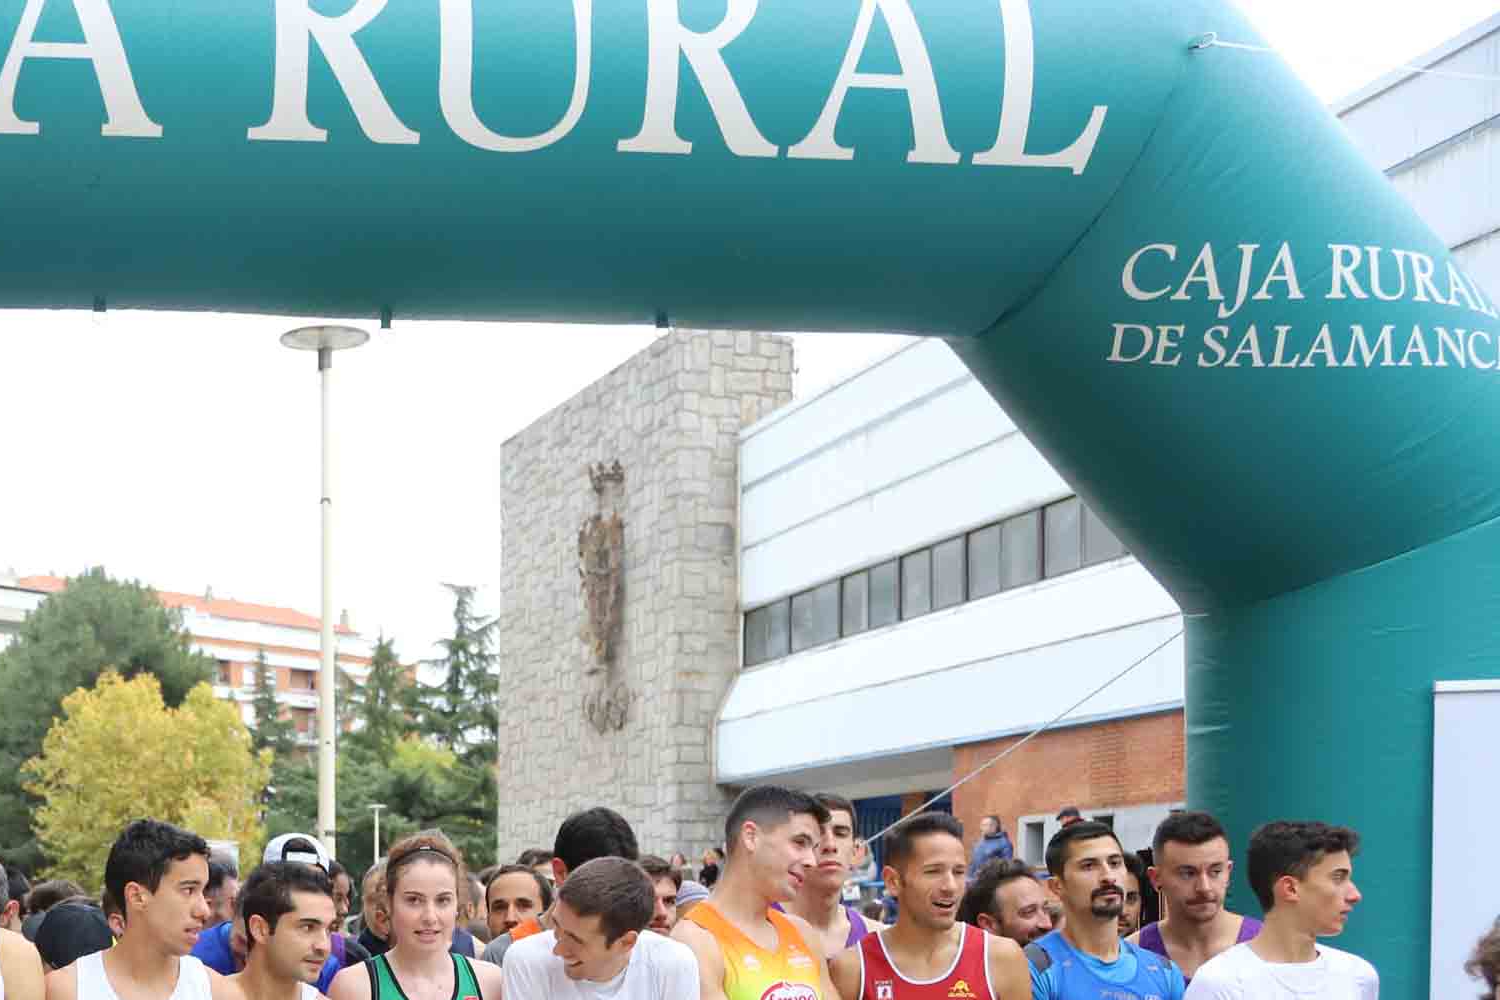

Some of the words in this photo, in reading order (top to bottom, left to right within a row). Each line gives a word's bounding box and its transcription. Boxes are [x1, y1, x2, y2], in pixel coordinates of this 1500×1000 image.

[247, 0, 1109, 175] RURAL
[1121, 241, 1305, 319] CAJA
[1324, 243, 1499, 319] RURAL
[1106, 323, 1185, 366] DE
